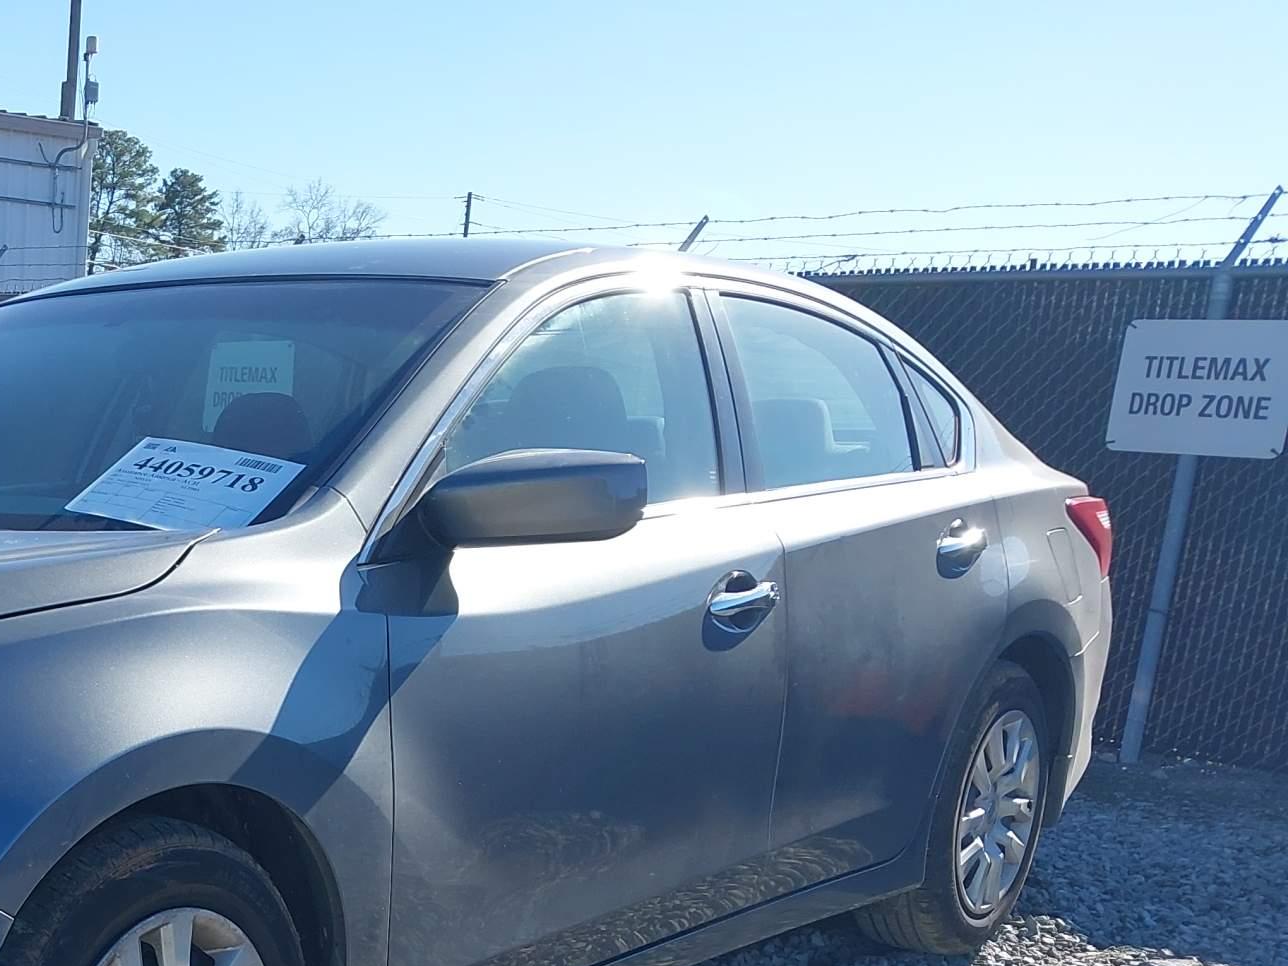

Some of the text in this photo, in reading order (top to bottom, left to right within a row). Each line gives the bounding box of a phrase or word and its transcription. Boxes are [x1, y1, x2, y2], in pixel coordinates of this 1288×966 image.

[218, 366, 278, 384] TITLEMAX
[1144, 355, 1272, 382] TITLEMAX
[212, 391, 243, 408] DR
[1128, 391, 1272, 420] DROP ZONE
[133, 456, 265, 493] 44059718
